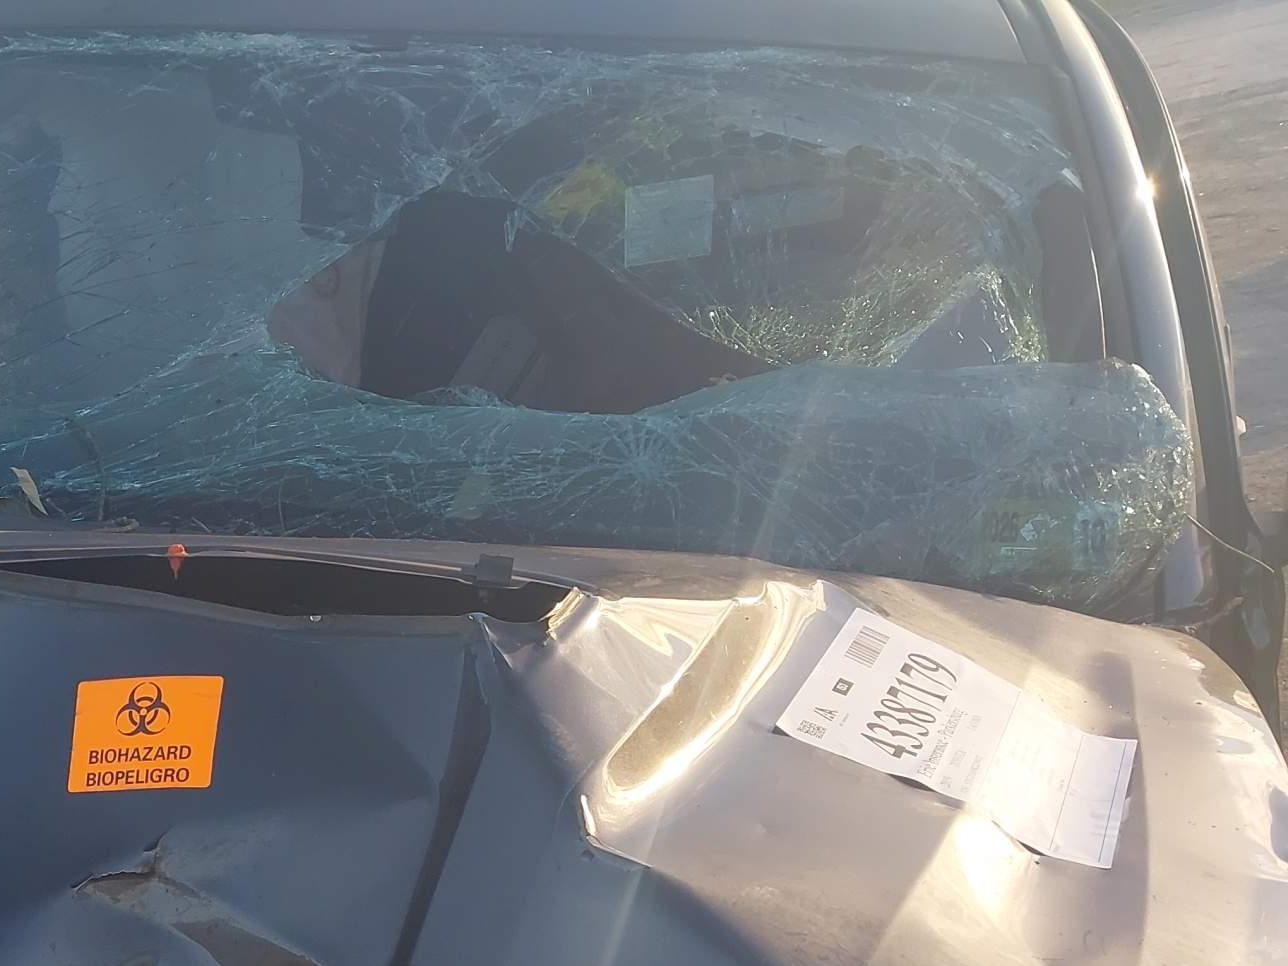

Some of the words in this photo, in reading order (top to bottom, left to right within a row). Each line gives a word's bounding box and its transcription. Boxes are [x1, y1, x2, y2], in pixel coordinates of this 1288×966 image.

[860, 652, 958, 760] 43387179
[88, 745, 192, 765] BIOHAZARD
[86, 767, 190, 787] BIOPELIGRO
